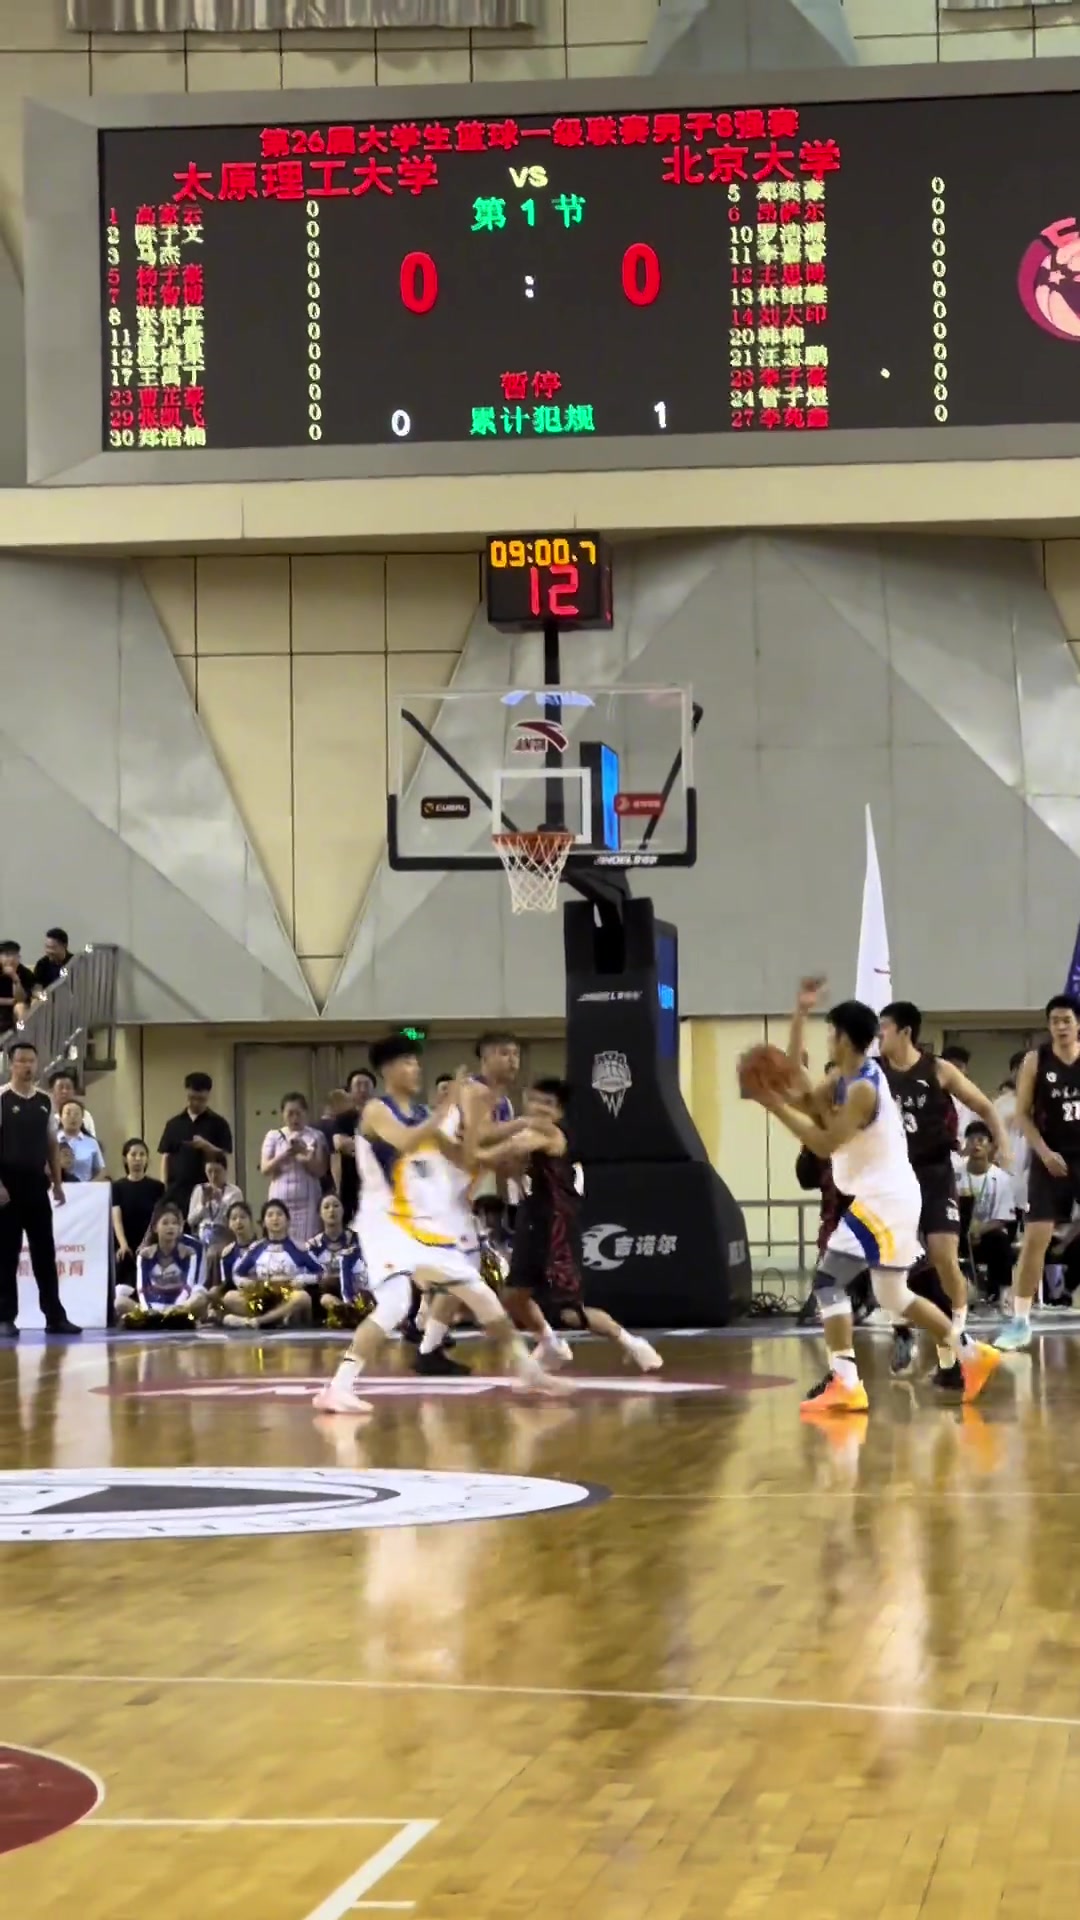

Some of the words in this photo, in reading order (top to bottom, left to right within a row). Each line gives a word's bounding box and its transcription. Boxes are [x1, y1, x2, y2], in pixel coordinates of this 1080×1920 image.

[260, 108, 799, 157] 第26届大学生篮球一级联赛男子8强赛
[662, 139, 840, 185] 北京大学
[173, 155, 438, 201] 太原理工大学
[728, 184, 740, 202] 5
[932, 177, 945, 194] 0
[110, 207, 118, 224] 1
[306, 200, 319, 217] 0
[728, 205, 740, 221] 6
[932, 197, 945, 215] 0
[107, 226, 119, 244] 2
[306, 221, 319, 237] 0
[730, 225, 753, 244] 10
[932, 218, 945, 235] 0
[108, 247, 119, 265] 3
[307, 241, 320, 258] 0
[730, 246, 751, 264] 11
[932, 239, 945, 256] 0
[108, 267, 120, 285] 5
[307, 262, 320, 278] 0
[400, 251, 438, 313] 0
[622, 243, 661, 306] 0
[732, 266, 753, 284] 12
[932, 260, 946, 277] 0
[109, 288, 119, 304] 7
[307, 281, 320, 298] 0
[731, 287, 753, 306] 13
[933, 280, 946, 298] 0
[308, 302, 320, 319] 0
[733, 307, 753, 326] 14
[933, 301, 947, 318] 0
[111, 329, 131, 346] 11
[308, 322, 320, 340] 0
[730, 328, 755, 346] 20
[933, 322, 947, 339] 0
[111, 348, 133, 366] 12
[308, 342, 321, 360] 0
[730, 348, 752, 366] 21
[933, 343, 947, 360] 0
[111, 368, 133, 386] 17
[308, 363, 321, 380] 0
[934, 362, 947, 380] 0
[111, 389, 133, 406] 23
[309, 383, 322, 400] 0
[500, 371, 562, 400] 暂停
[730, 389, 754, 408] 24
[934, 382, 948, 400] 0
[111, 410, 134, 427] 29
[309, 403, 322, 420] 0
[391, 409, 411, 436] 0
[470, 404, 595, 435] 累计犯规
[654, 401, 666, 428] 1
[732, 410, 754, 427] 27
[934, 404, 948, 422] 0
[110, 429, 134, 446] 30
[309, 424, 322, 440] 0
[491, 538, 596, 568] 09:00.7
[530, 564, 579, 616] 12
